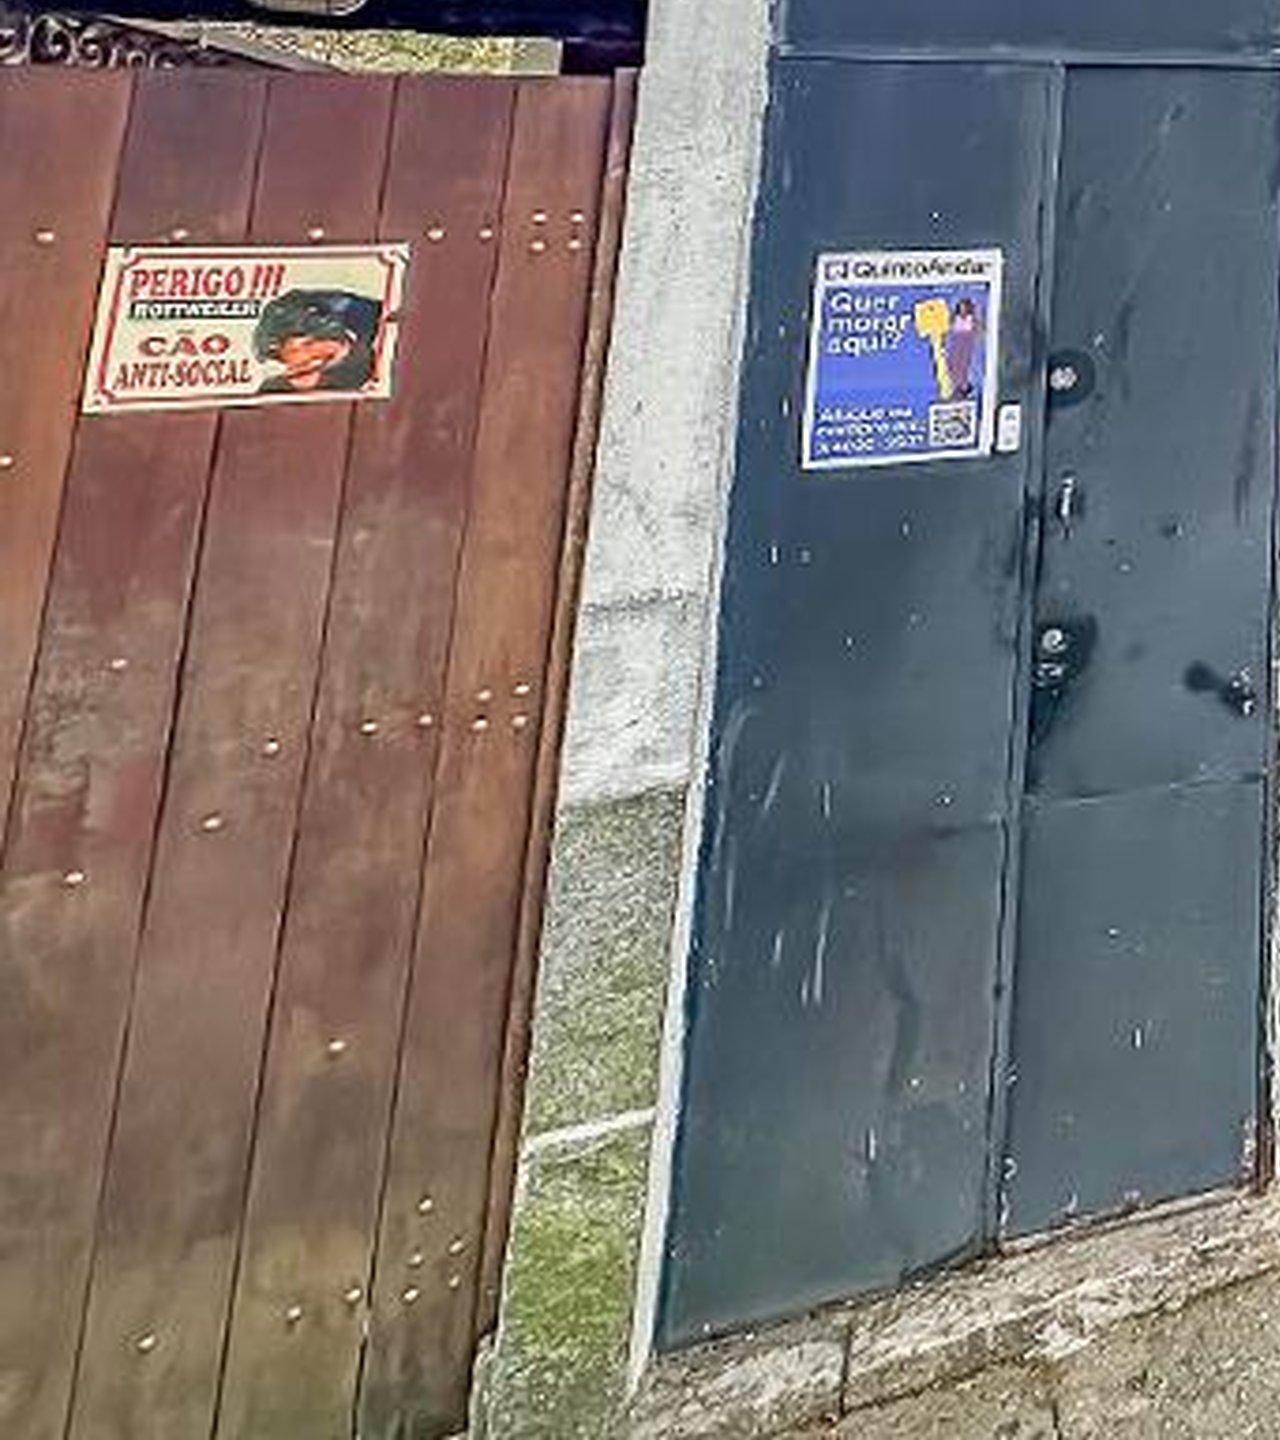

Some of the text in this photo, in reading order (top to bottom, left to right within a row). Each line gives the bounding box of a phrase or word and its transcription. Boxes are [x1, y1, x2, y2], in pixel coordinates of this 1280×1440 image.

[853, 257, 992, 279] QuintoAndar
[130, 266, 244, 298] PERIGO
[831, 291, 899, 312] Quer
[827, 314, 912, 333] morar
[138, 329, 230, 357] CÃO
[827, 331, 901, 357] aqui?
[113, 359, 252, 390] ANTI-SOCIAL
